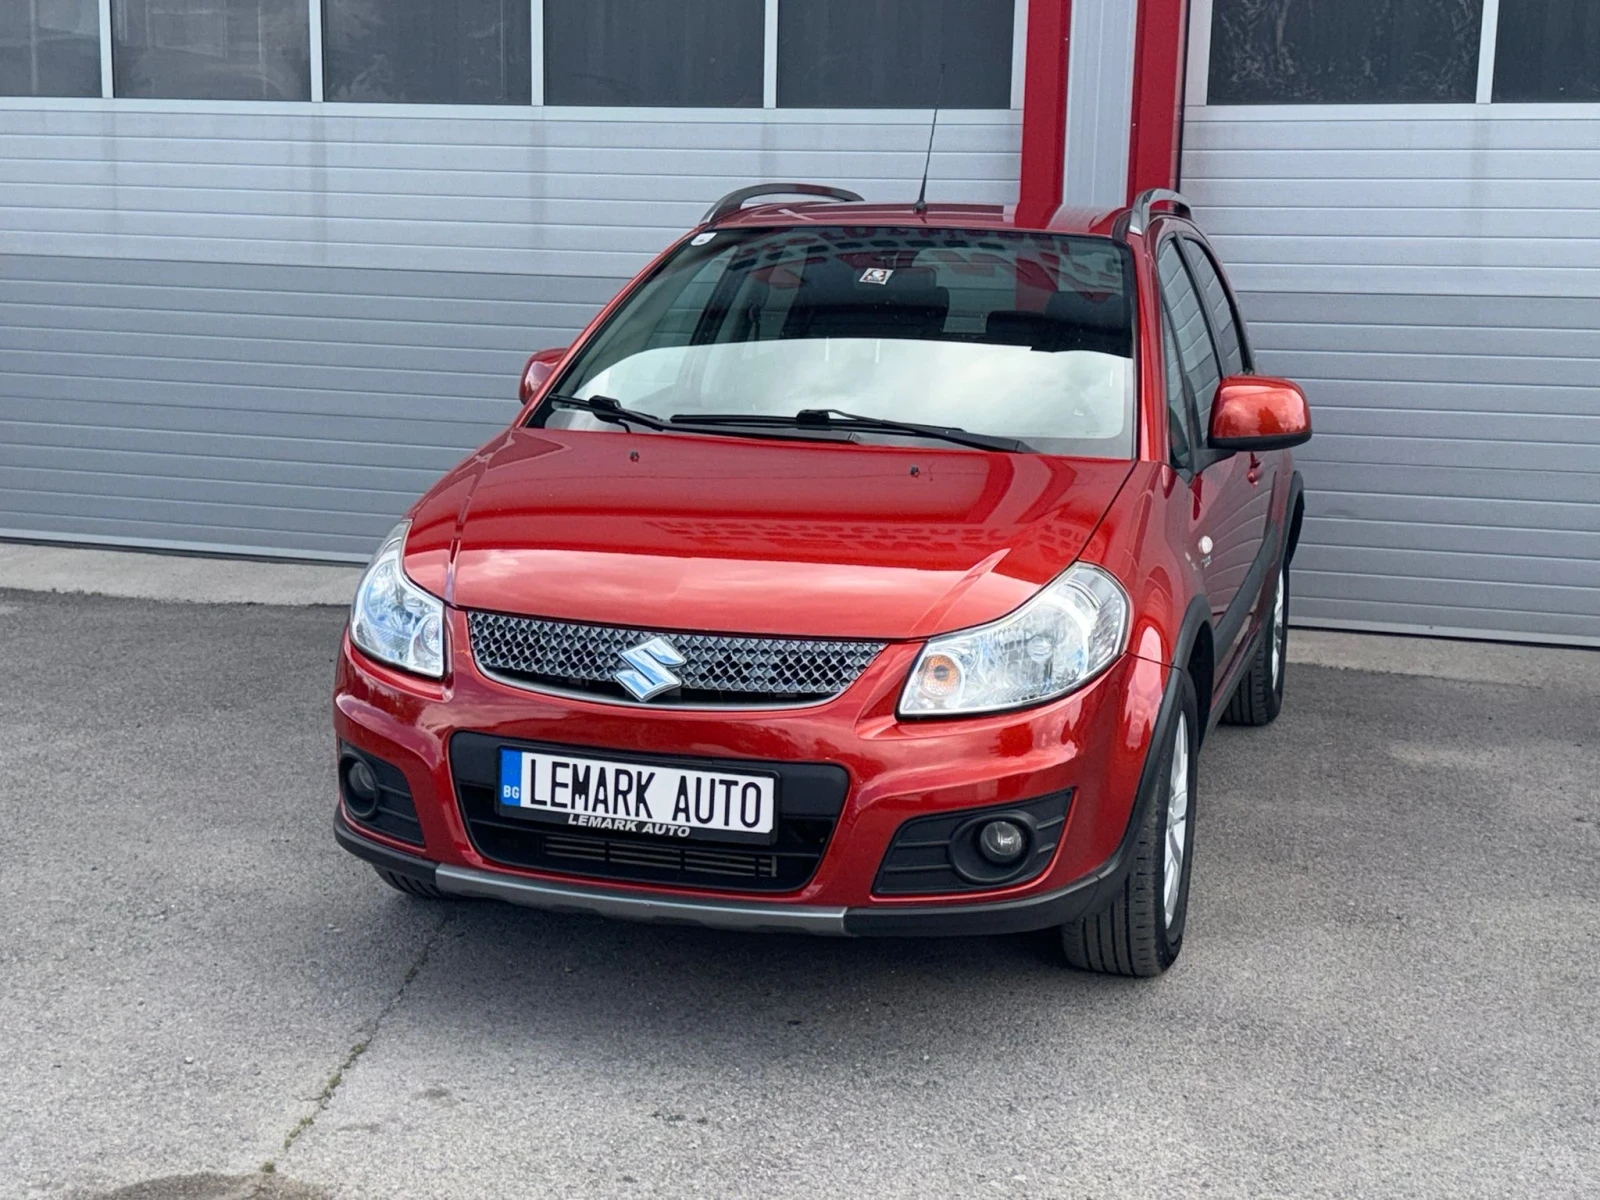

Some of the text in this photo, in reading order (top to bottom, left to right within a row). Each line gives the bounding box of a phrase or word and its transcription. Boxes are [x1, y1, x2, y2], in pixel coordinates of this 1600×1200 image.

[503, 785, 520, 799] BG
[530, 759, 762, 828] LEMARK AUTO
[568, 814, 690, 838] LEMARK AUTO
